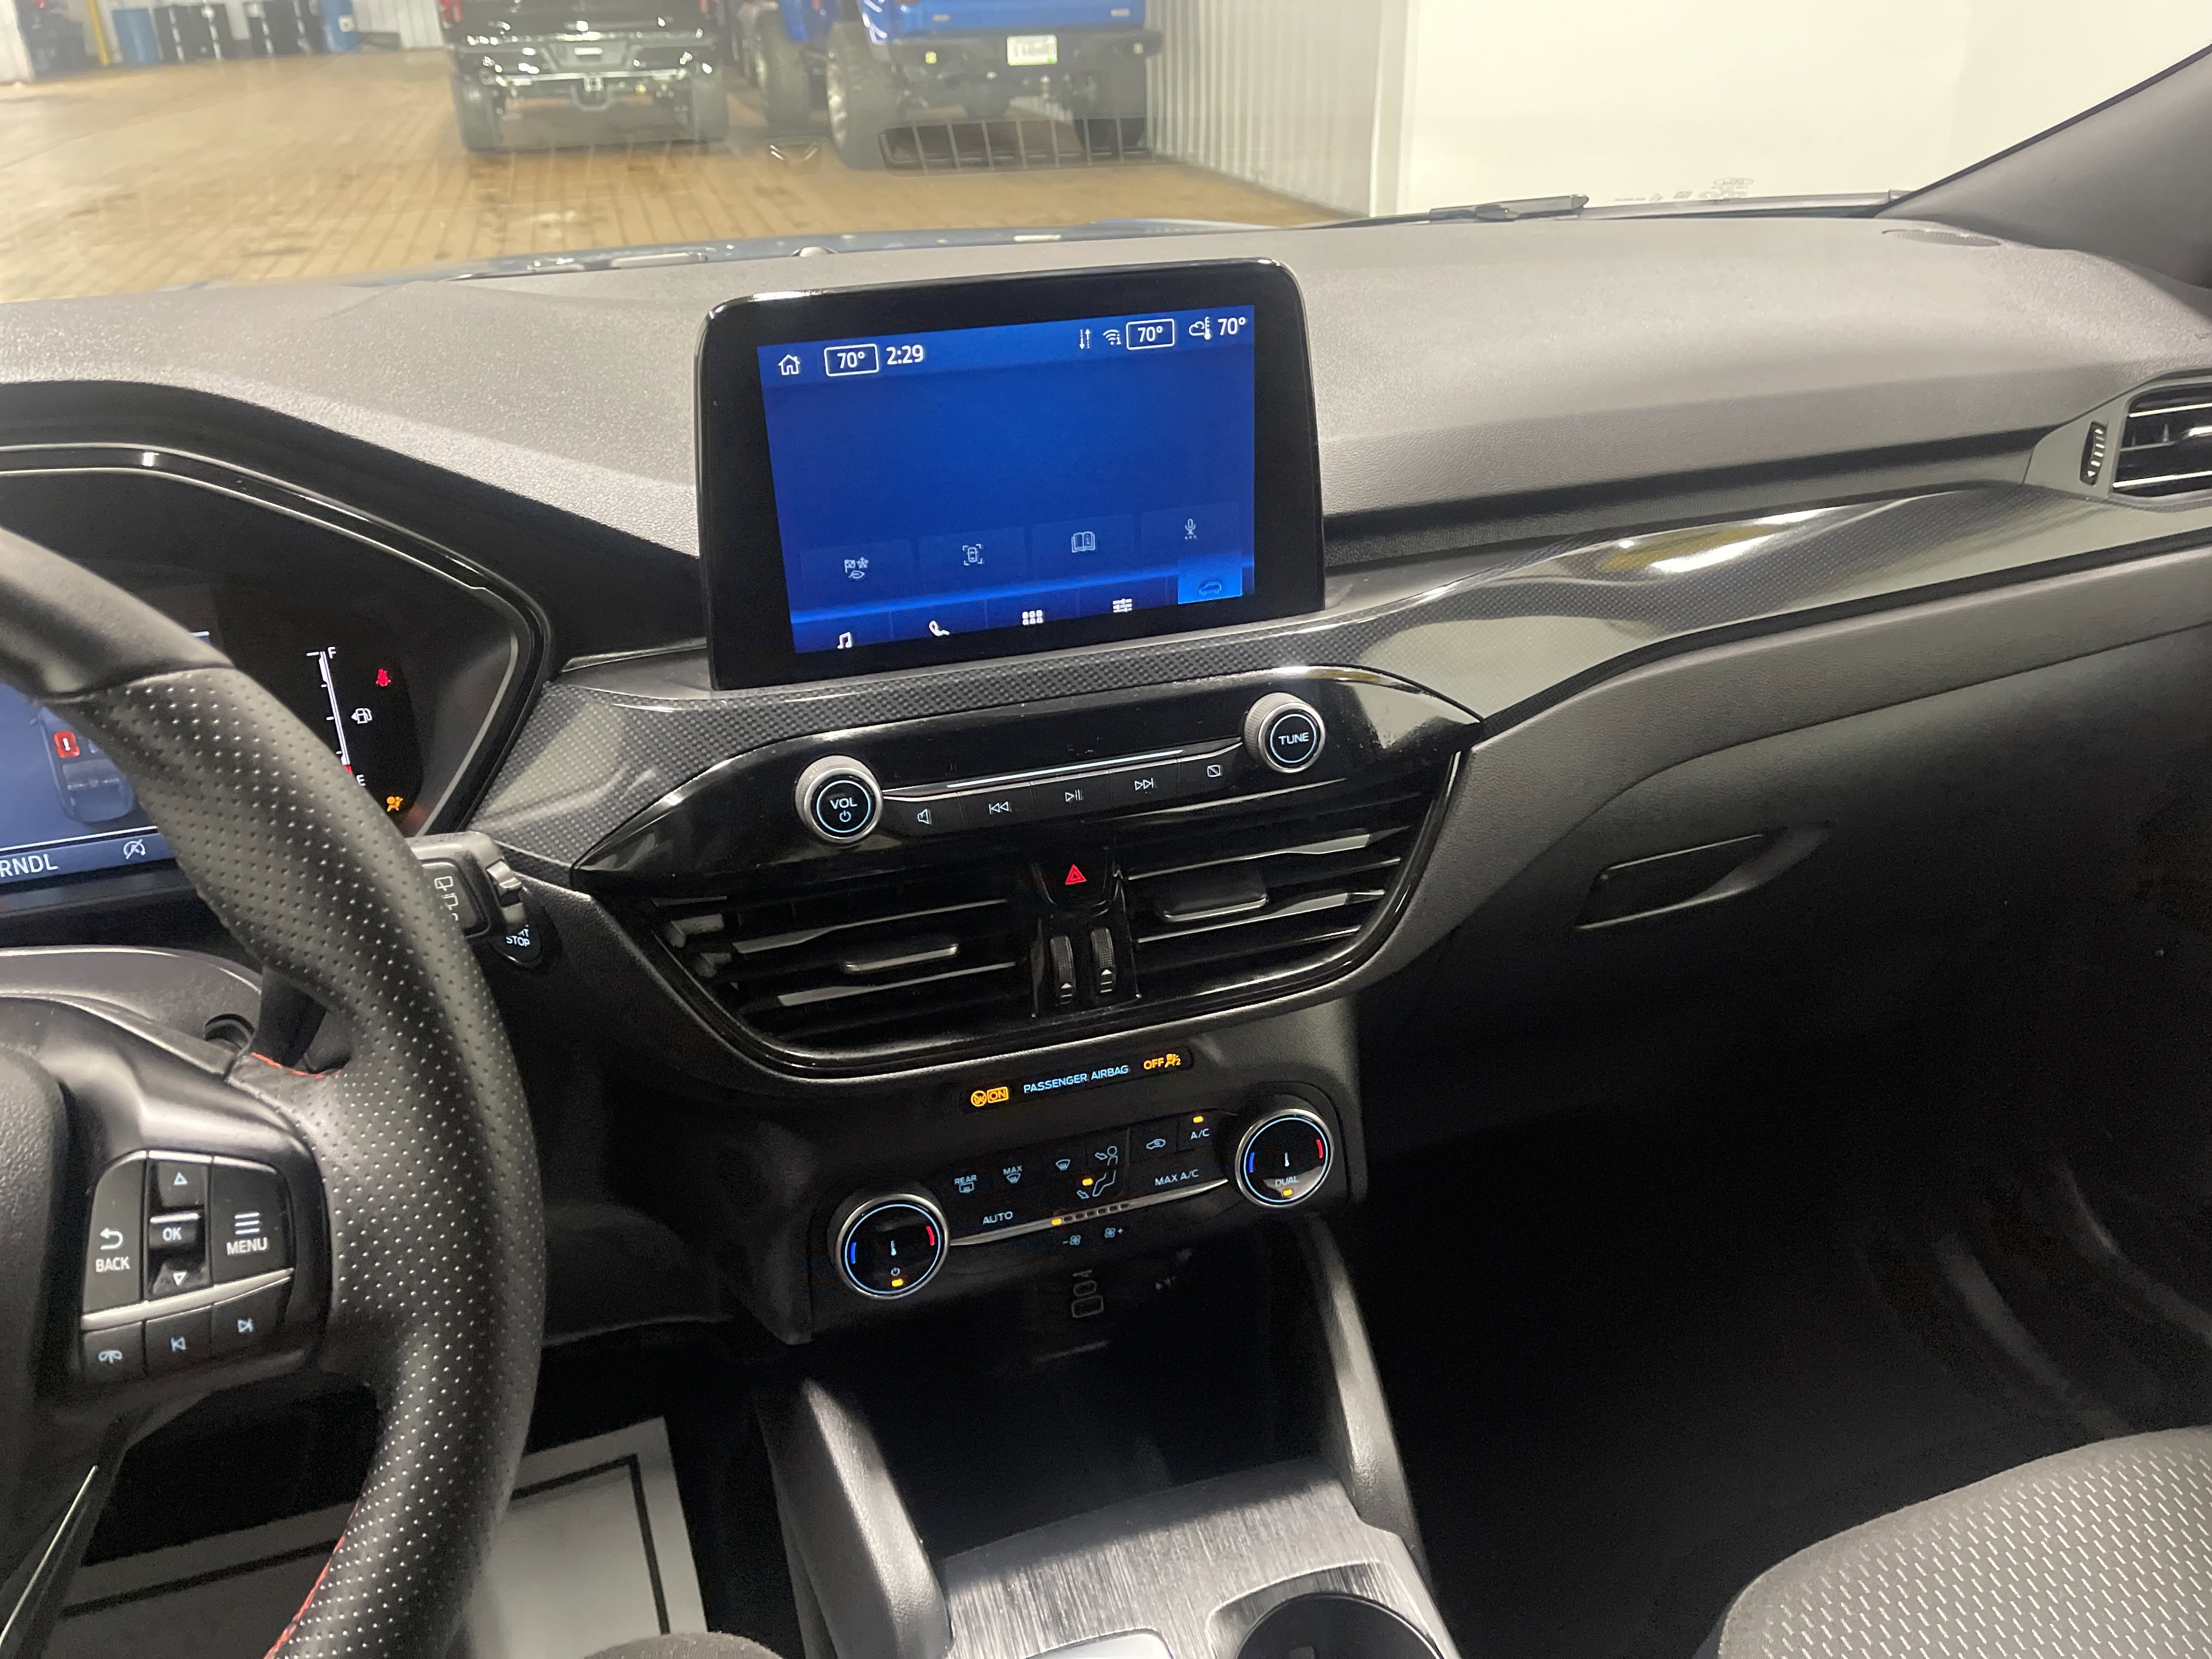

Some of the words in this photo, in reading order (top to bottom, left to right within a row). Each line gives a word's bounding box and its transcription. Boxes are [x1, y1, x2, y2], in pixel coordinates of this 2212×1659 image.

[886, 345, 924, 365] 2:29
[328, 646, 336, 659] F
[1278, 732, 1310, 746] TUNE
[356, 774, 366, 786] E
[830, 797, 857, 810] VOL
[506, 935, 531, 947] STOP
[1143, 1057, 1164, 1070] OFF
[1023, 1073, 1088, 1093] PASSENGER
[1091, 1064, 1130, 1080] AIRBAG
[989, 1090, 1007, 1101] ON
[1190, 1128, 1210, 1140] A/C
[1003, 1165, 1023, 1175] MAX
[954, 1175, 978, 1186] REAR
[1155, 1173, 1178, 1187] MAX
[1180, 1168, 1199, 1181] A/C
[1275, 1176, 1300, 1187] DUAL
[983, 1211, 1014, 1224] AUTO
[162, 1227, 182, 1240] OK
[227, 1238, 268, 1256] MENU
[95, 1256, 131, 1273] BACK
